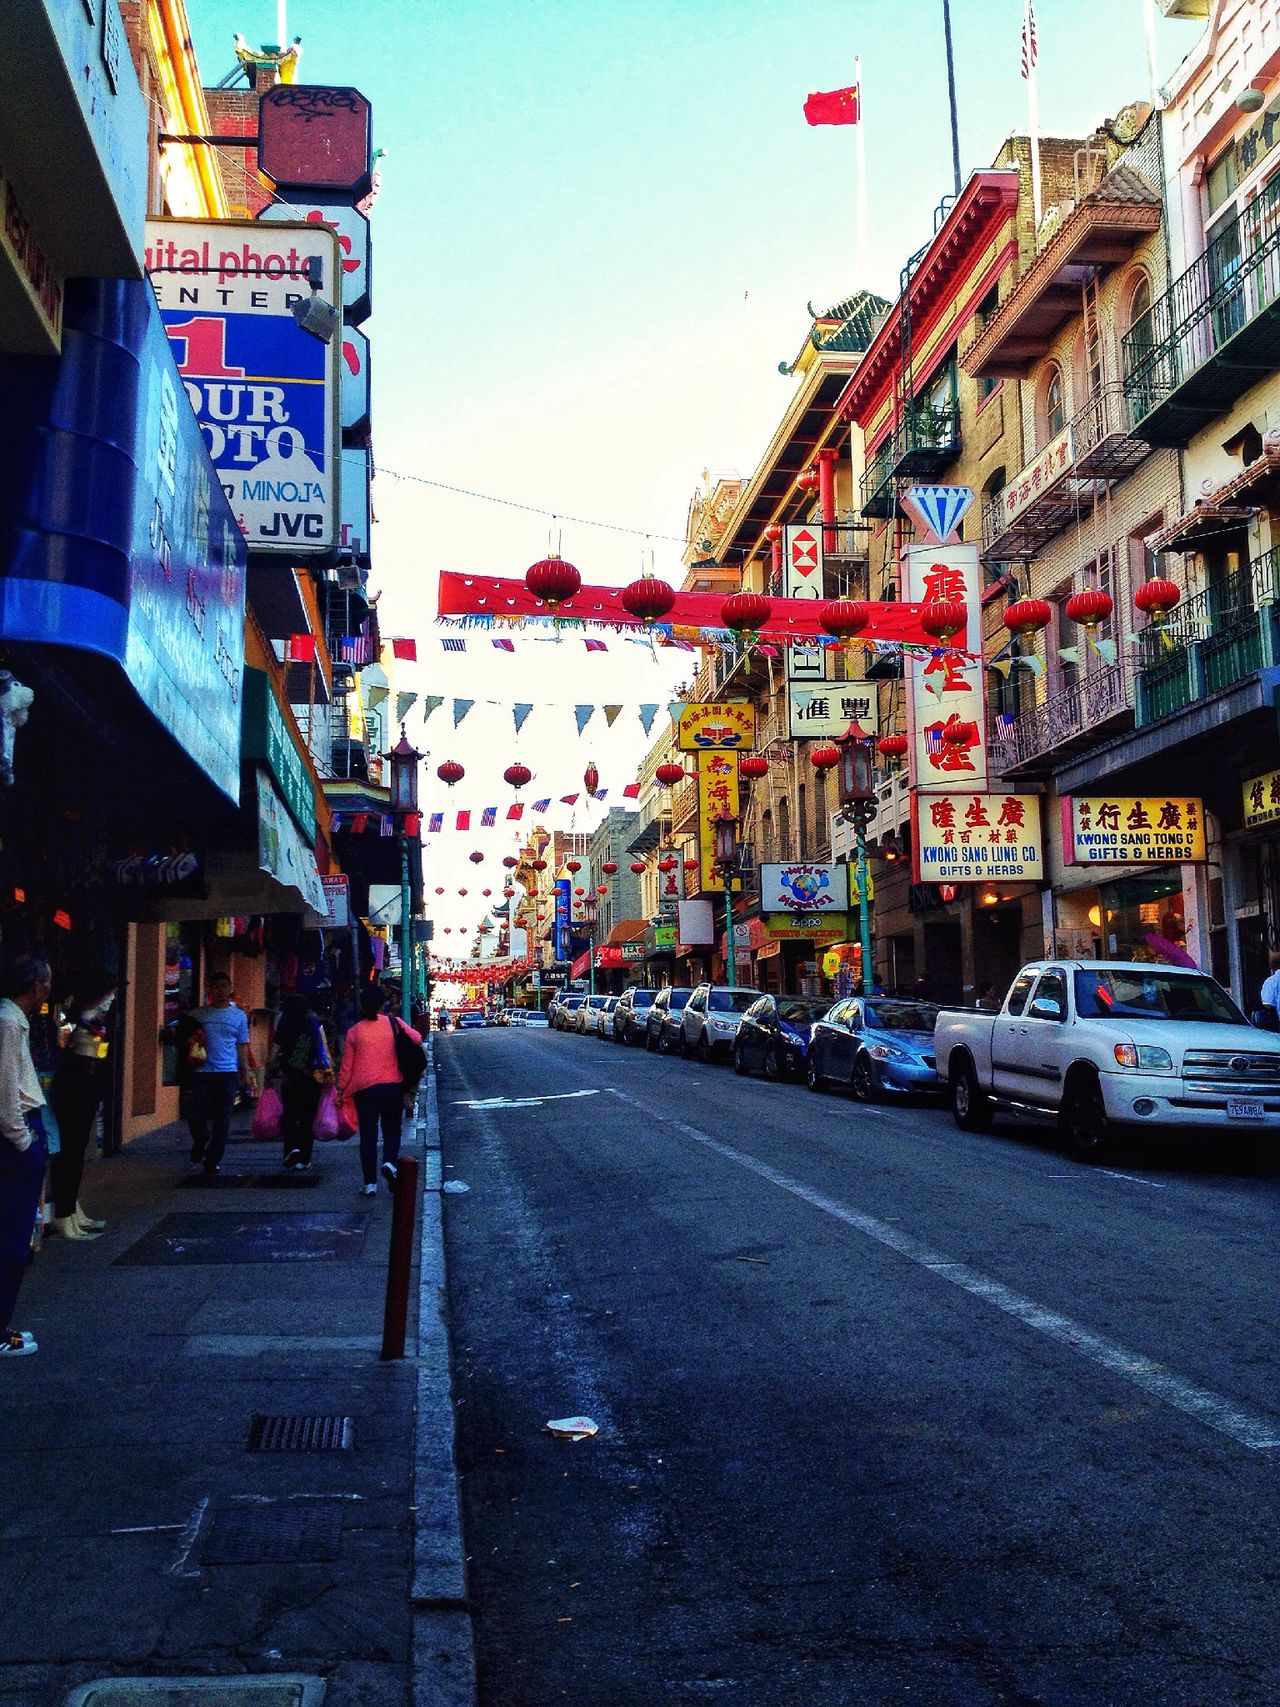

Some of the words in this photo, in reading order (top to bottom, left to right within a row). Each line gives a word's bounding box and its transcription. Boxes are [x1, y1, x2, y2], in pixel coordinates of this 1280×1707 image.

[260, 512, 323, 538] JVC
[1077, 833, 1117, 845] KWONG
[1120, 833, 1150, 844] SANG
[1154, 833, 1183, 844] TONG
[923, 846, 958, 863] KWONG
[962, 846, 988, 863] SANG
[992, 846, 1018, 862] LUNG
[1022, 846, 1039, 862] CO.
[1089, 848, 1127, 859] GIFTS
[1133, 848, 1142, 859] &
[1148, 847, 1192, 859] HERBS
[940, 865, 971, 876] GIFTS
[976, 865, 983, 875] &
[987, 865, 1024, 875] HERBS
